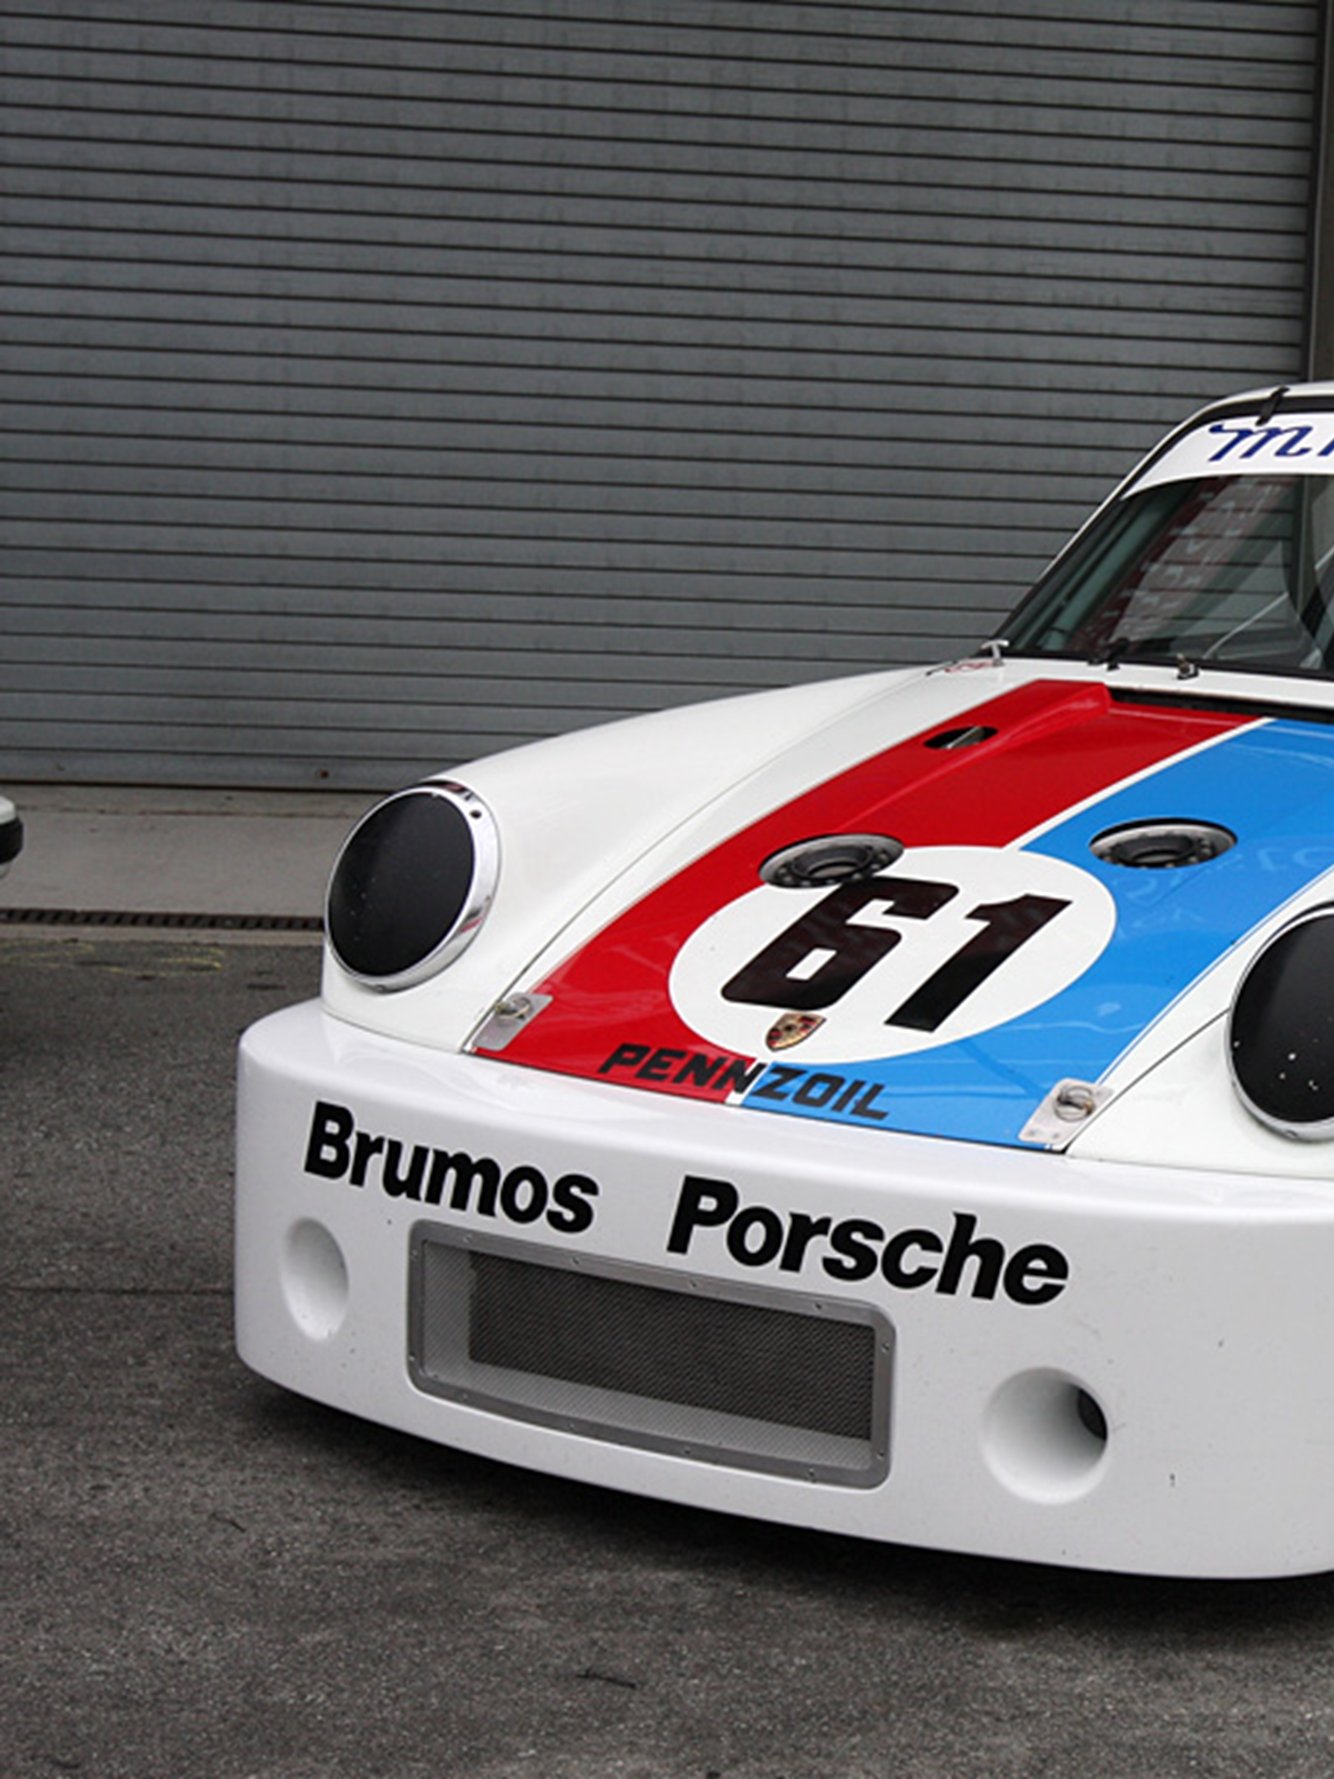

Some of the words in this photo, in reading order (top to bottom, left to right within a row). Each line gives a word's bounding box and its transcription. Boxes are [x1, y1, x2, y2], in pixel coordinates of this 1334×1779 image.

[720, 875, 1074, 1034] 61
[597, 1043, 889, 1121] PENNZOIL
[303, 1100, 600, 1234] Brumos
[666, 1174, 1070, 1306] Porsche
